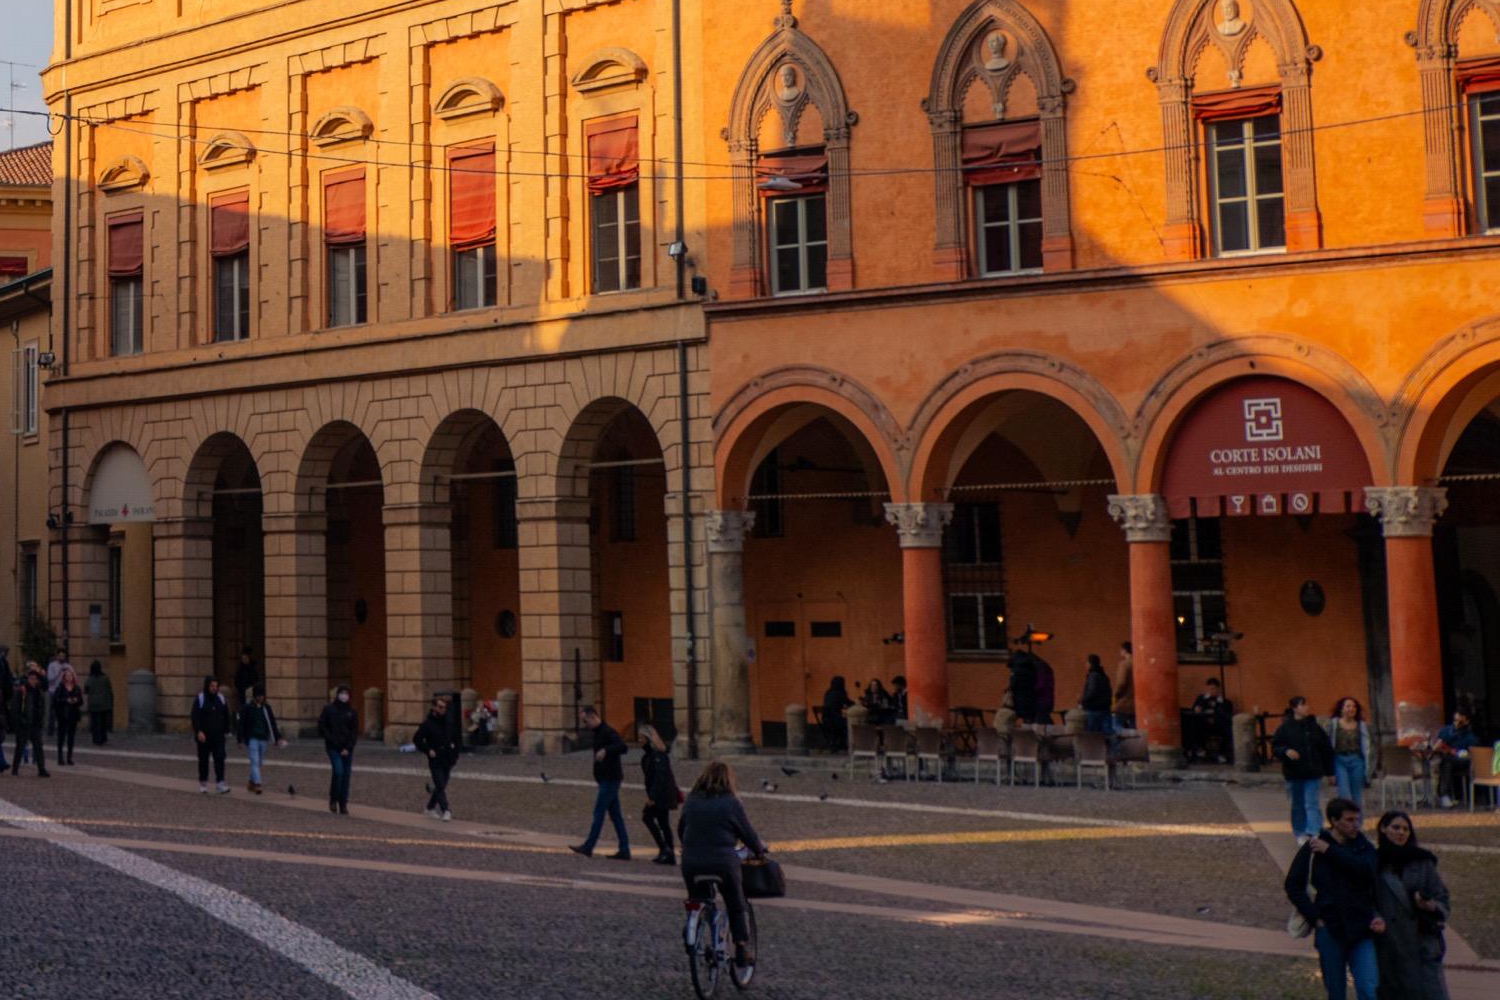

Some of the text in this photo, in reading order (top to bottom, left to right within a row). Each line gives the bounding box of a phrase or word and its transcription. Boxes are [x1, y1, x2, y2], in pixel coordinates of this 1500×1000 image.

[1211, 445, 1321, 463] CORTE ISOLANI
[1225, 466, 1261, 475] CENTRO
[1263, 464, 1279, 474] DEI
[1282, 463, 1322, 473] DESIDERI
